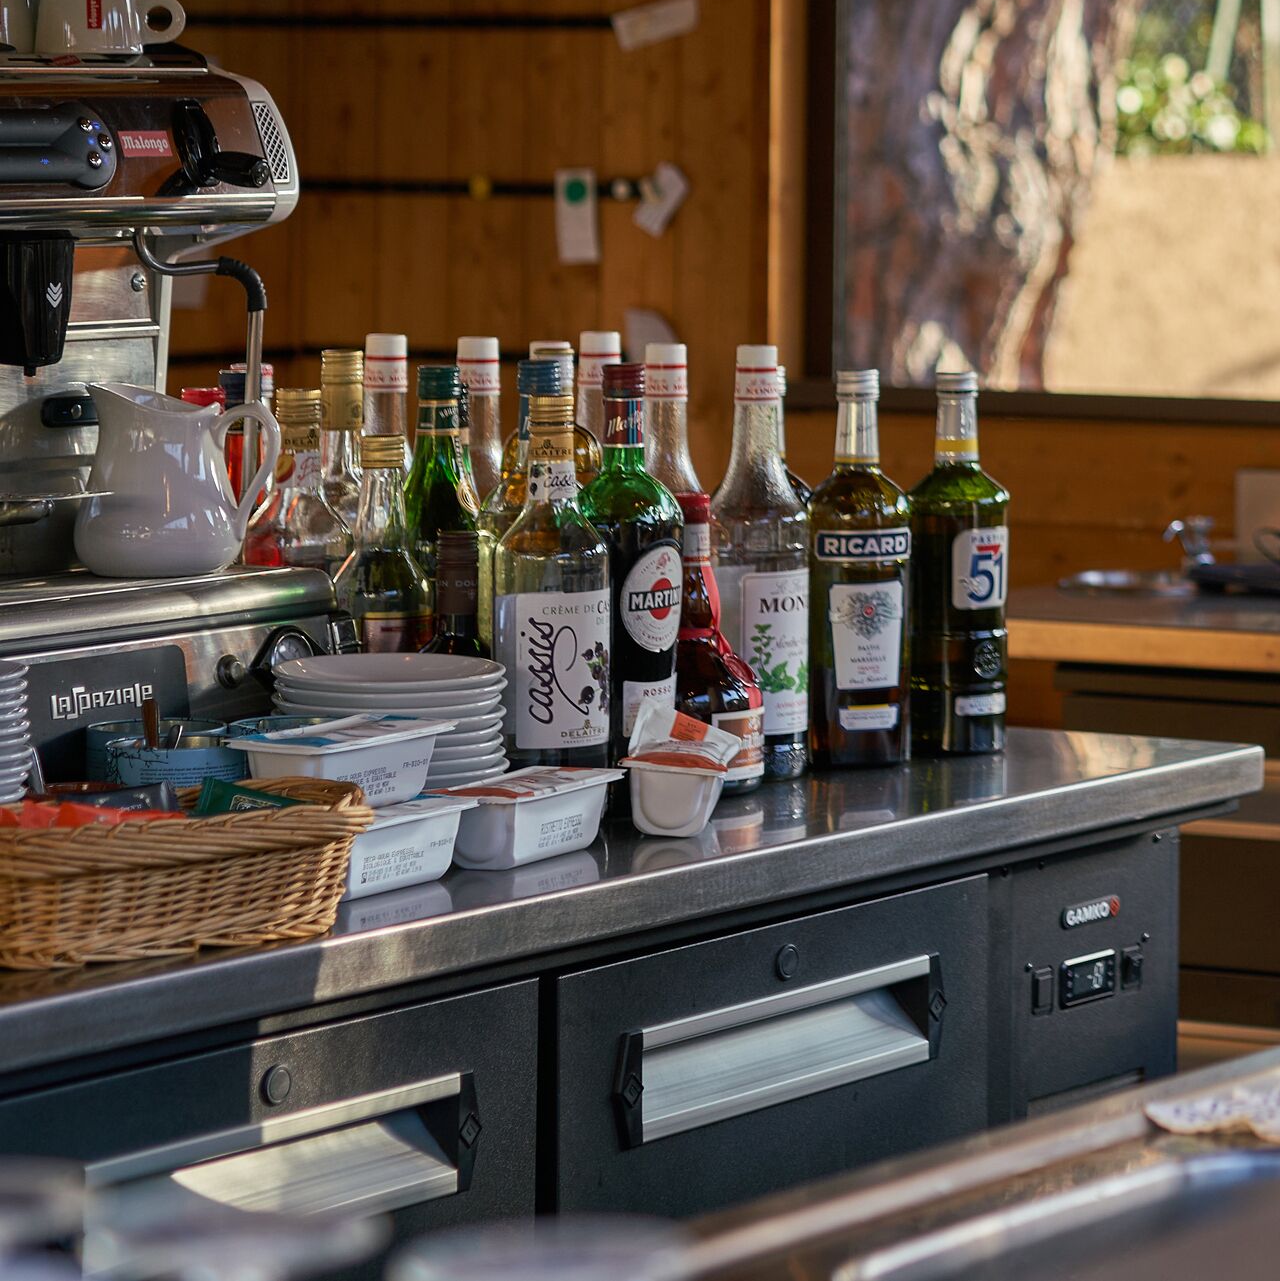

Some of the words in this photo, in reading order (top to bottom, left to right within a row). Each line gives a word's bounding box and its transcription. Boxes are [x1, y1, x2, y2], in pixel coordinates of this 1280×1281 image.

[122, 135, 169, 153] Malongo
[823, 535, 907, 555] RICARD
[967, 553, 1003, 602] 51
[542, 604, 579, 616] CRÈME
[584, 605, 595, 614] DE
[759, 596, 808, 614] MON
[1066, 900, 1110, 926] GAMKO
